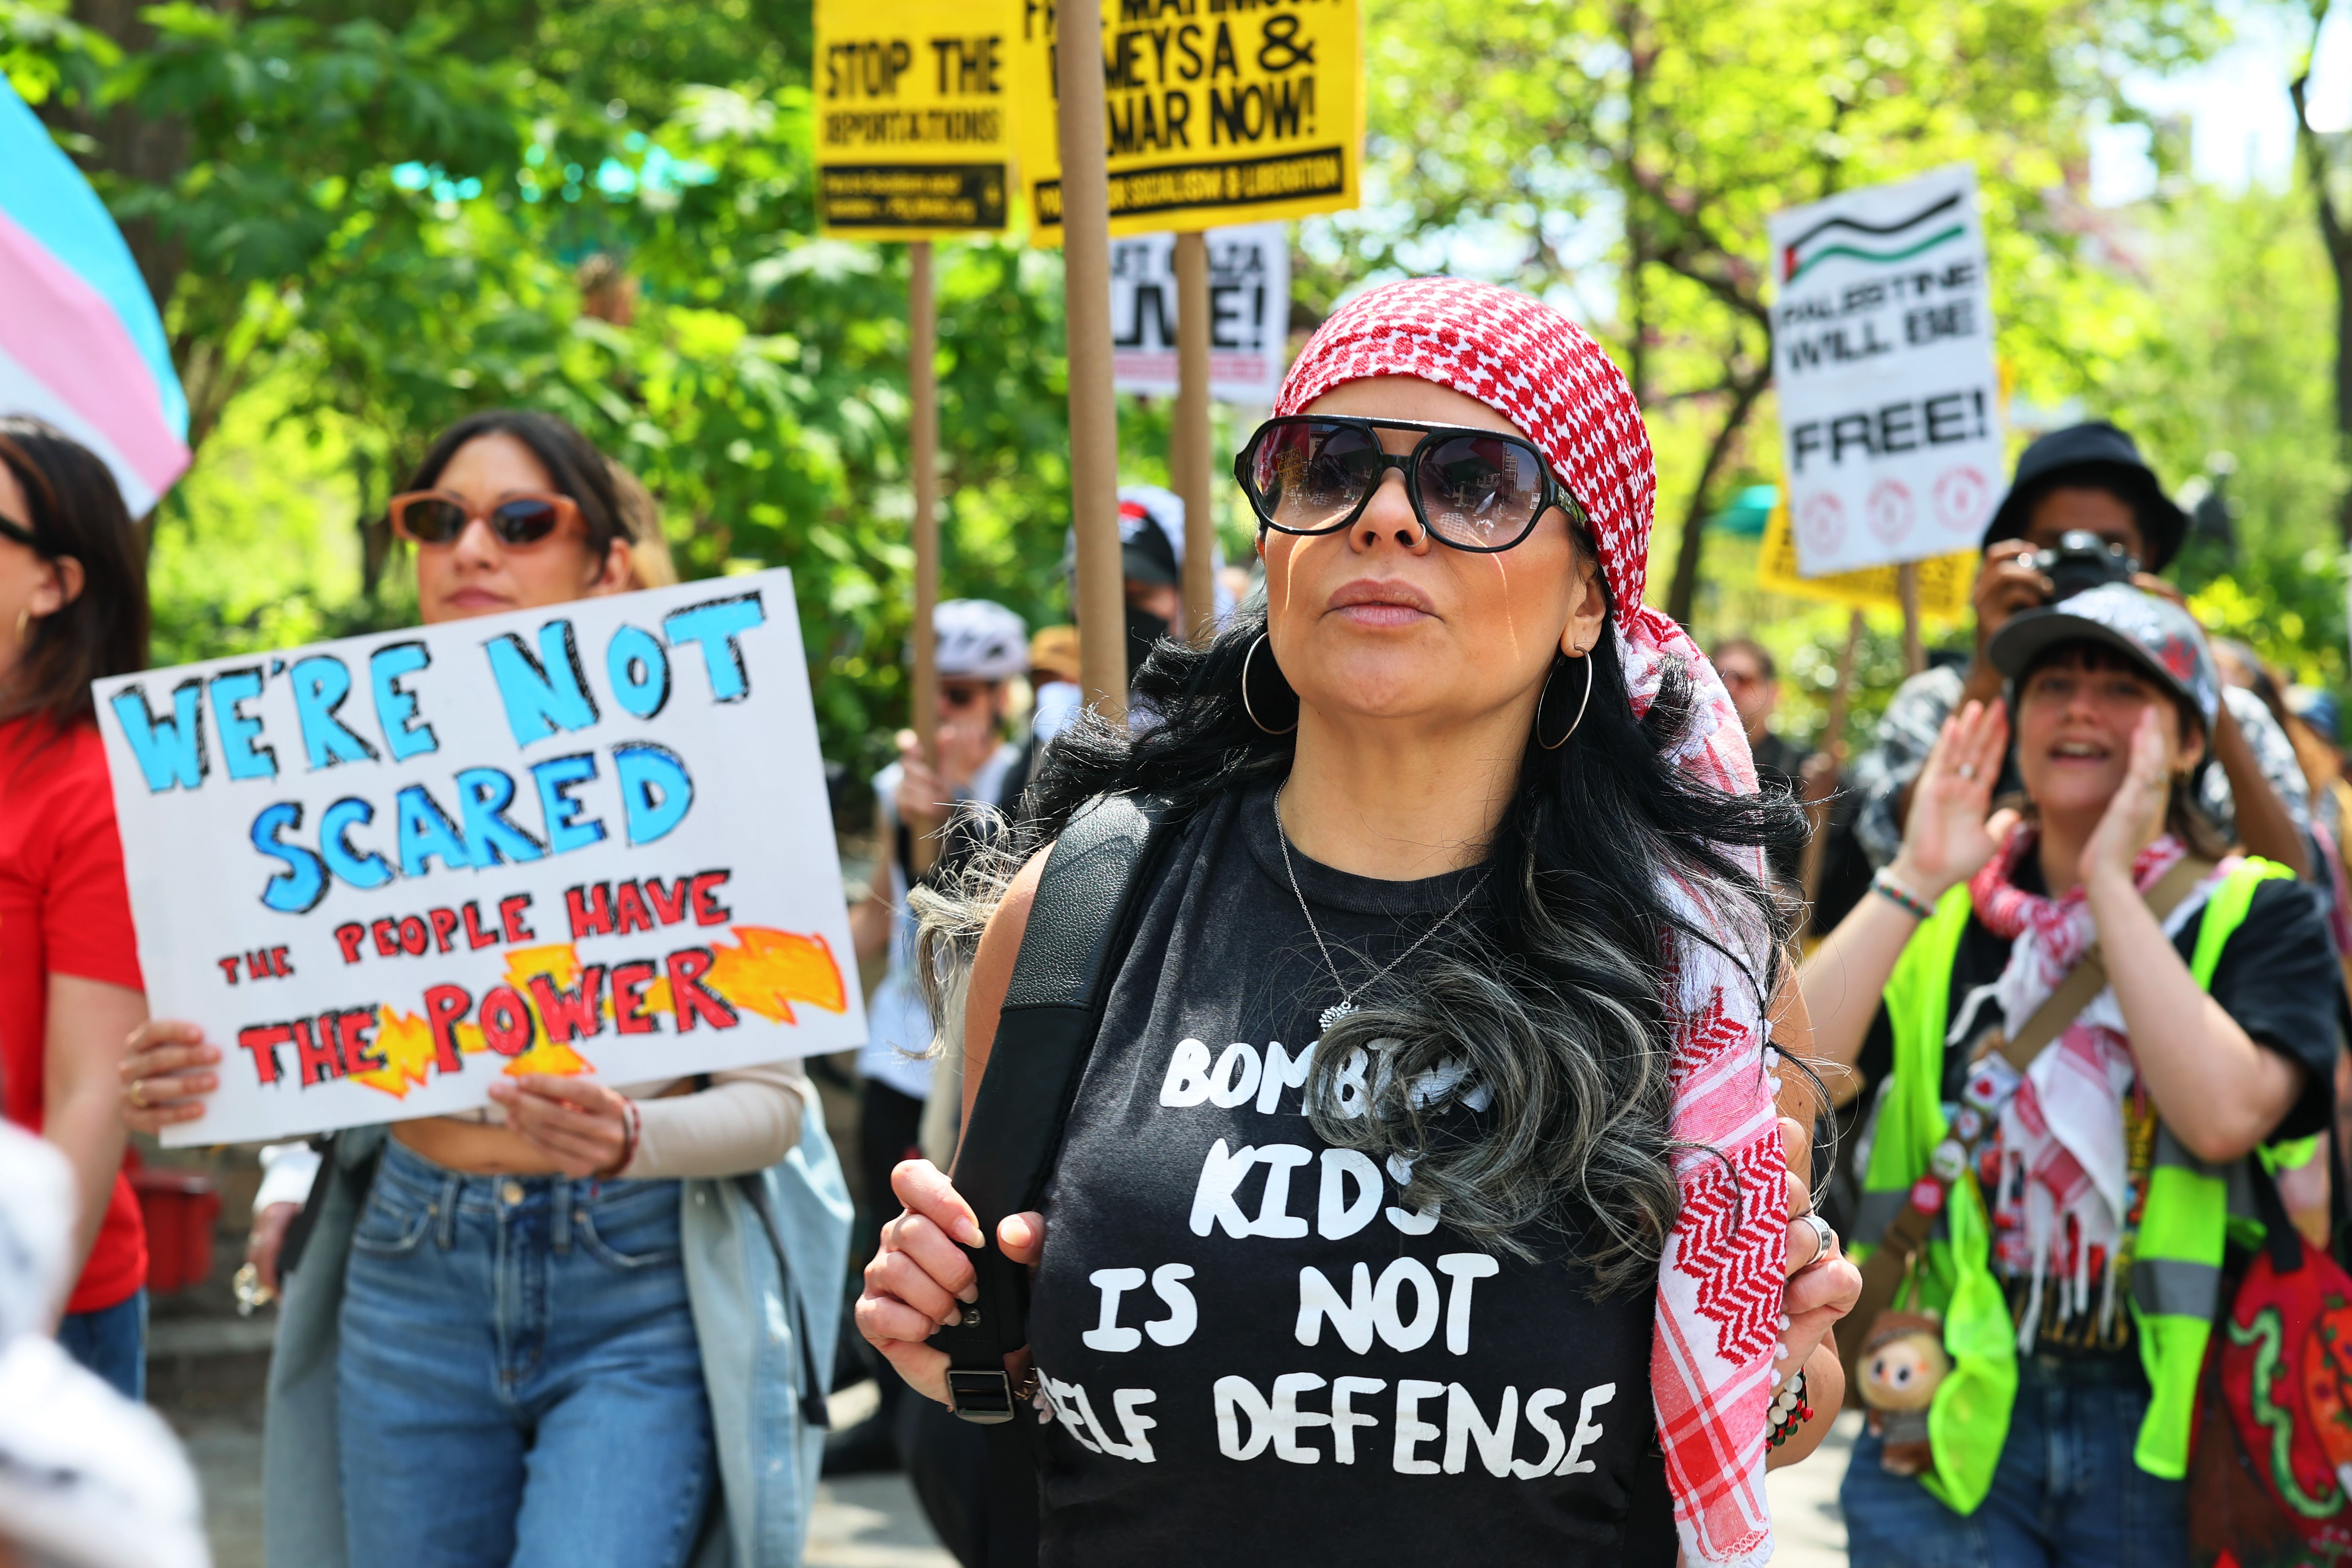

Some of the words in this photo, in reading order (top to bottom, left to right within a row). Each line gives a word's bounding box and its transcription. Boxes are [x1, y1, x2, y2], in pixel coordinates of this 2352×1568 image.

[826, 40, 912, 99] STOP
[928, 34, 1001, 96] THE
[1257, 14, 1314, 72] &
[1105, 89, 1190, 155] MAR
[1210, 75, 1312, 146] NOW!
[1782, 262, 1976, 326] PALESTINE
[1784, 319, 1893, 369] WILL
[1904, 296, 1976, 346] BE
[1790, 389, 1988, 472] FREE!
[109, 640, 439, 793] WE'RE
[484, 591, 767, 749] NOT
[249, 740, 695, 913] SCARED
[218, 945, 296, 985] THE
[334, 893, 534, 965] PEOPLE
[565, 868, 733, 942] HAVE
[237, 1004, 389, 1090] THE
[422, 945, 740, 1078] POWER
[1159, 1037, 1497, 1120] BOMBIN
[1189, 1138, 1441, 1241] KIDS
[1082, 1263, 1198, 1352] IS
[1294, 1253, 1499, 1355] NOT
[1213, 1372, 1617, 1480] DEFENSE
